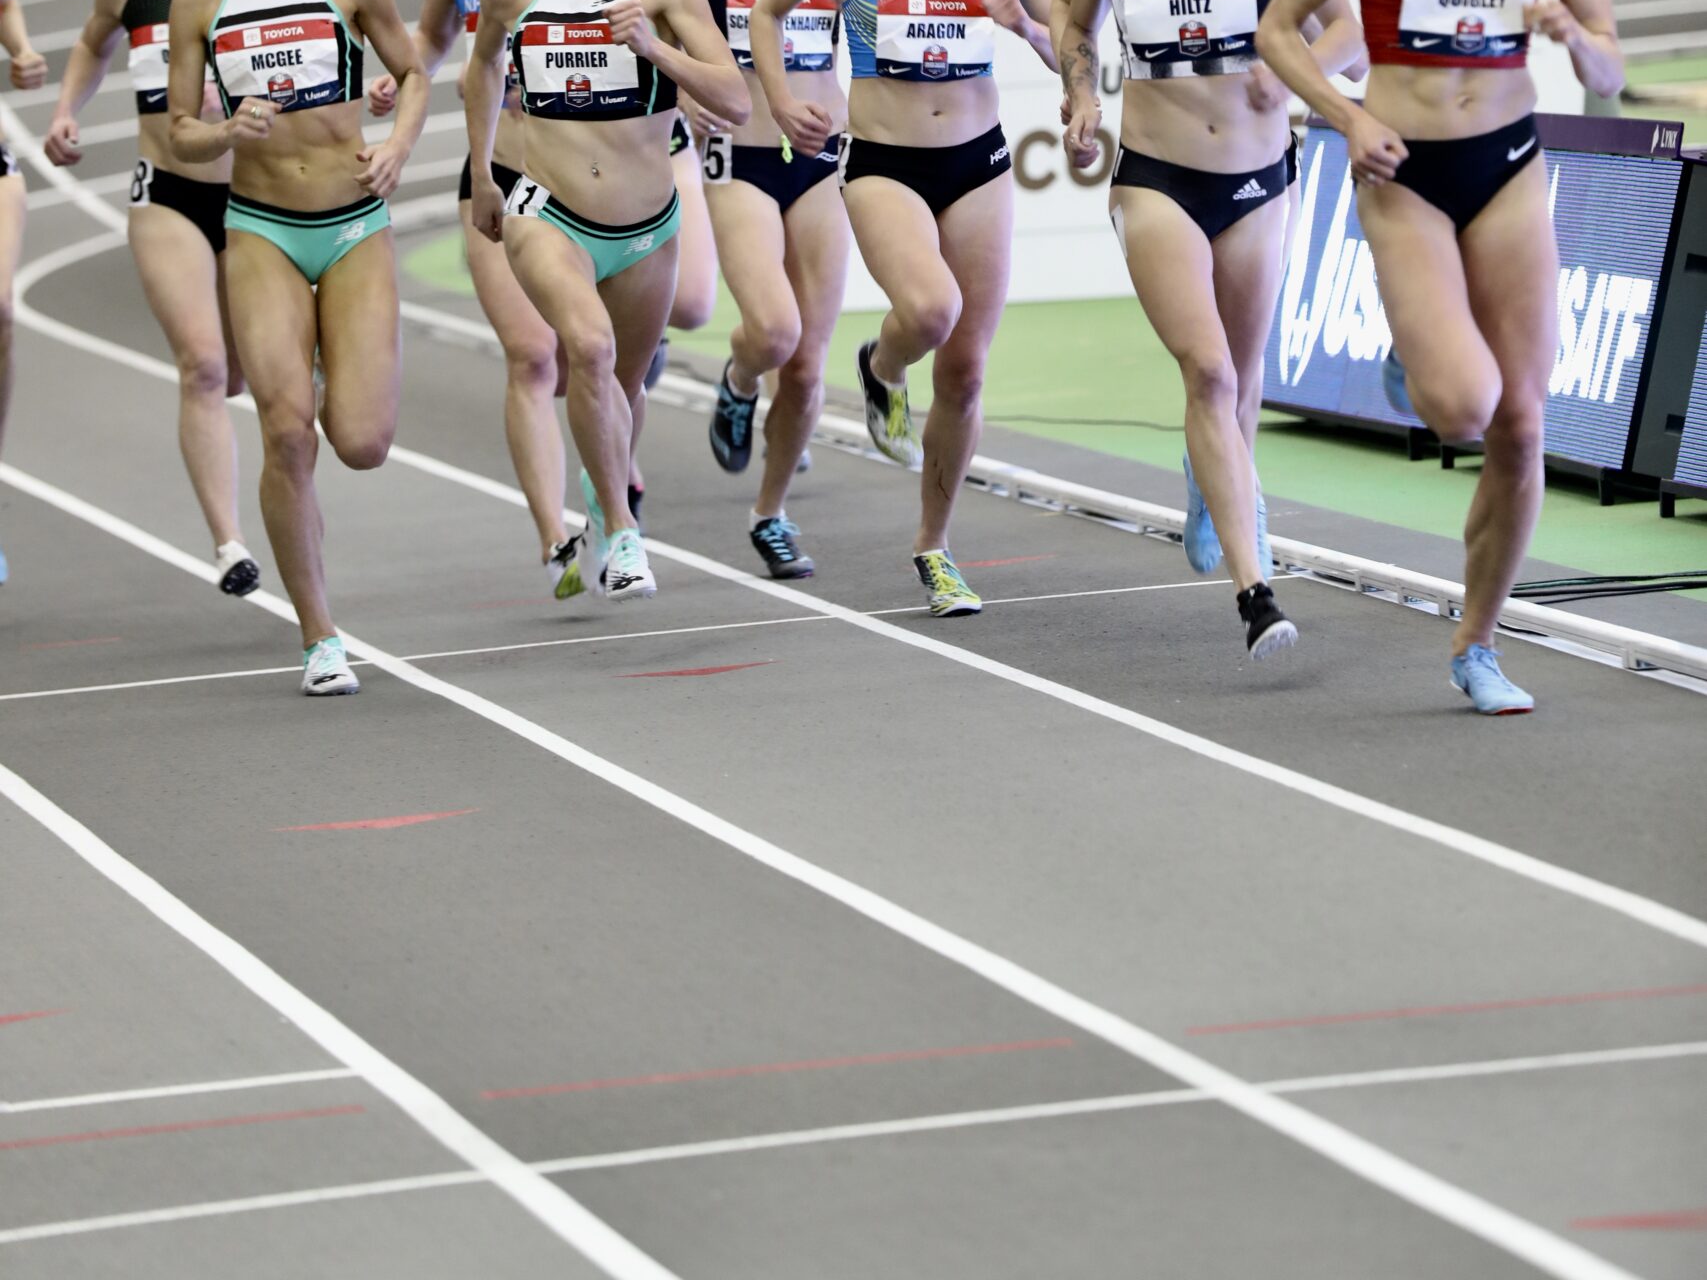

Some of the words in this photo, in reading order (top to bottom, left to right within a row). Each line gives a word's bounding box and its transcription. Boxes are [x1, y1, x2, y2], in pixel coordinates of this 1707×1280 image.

[928, 1, 967, 11] TOYOTA
[263, 26, 304, 40] TOYOTA
[567, 29, 604, 39] TOYOTA
[906, 22, 966, 40] ARAGON
[251, 48, 303, 71] MCGEE
[545, 51, 608, 69] PURRIER
[704, 136, 725, 181] 5
[131, 160, 148, 203] 8
[1232, 187, 1268, 201] adidas
